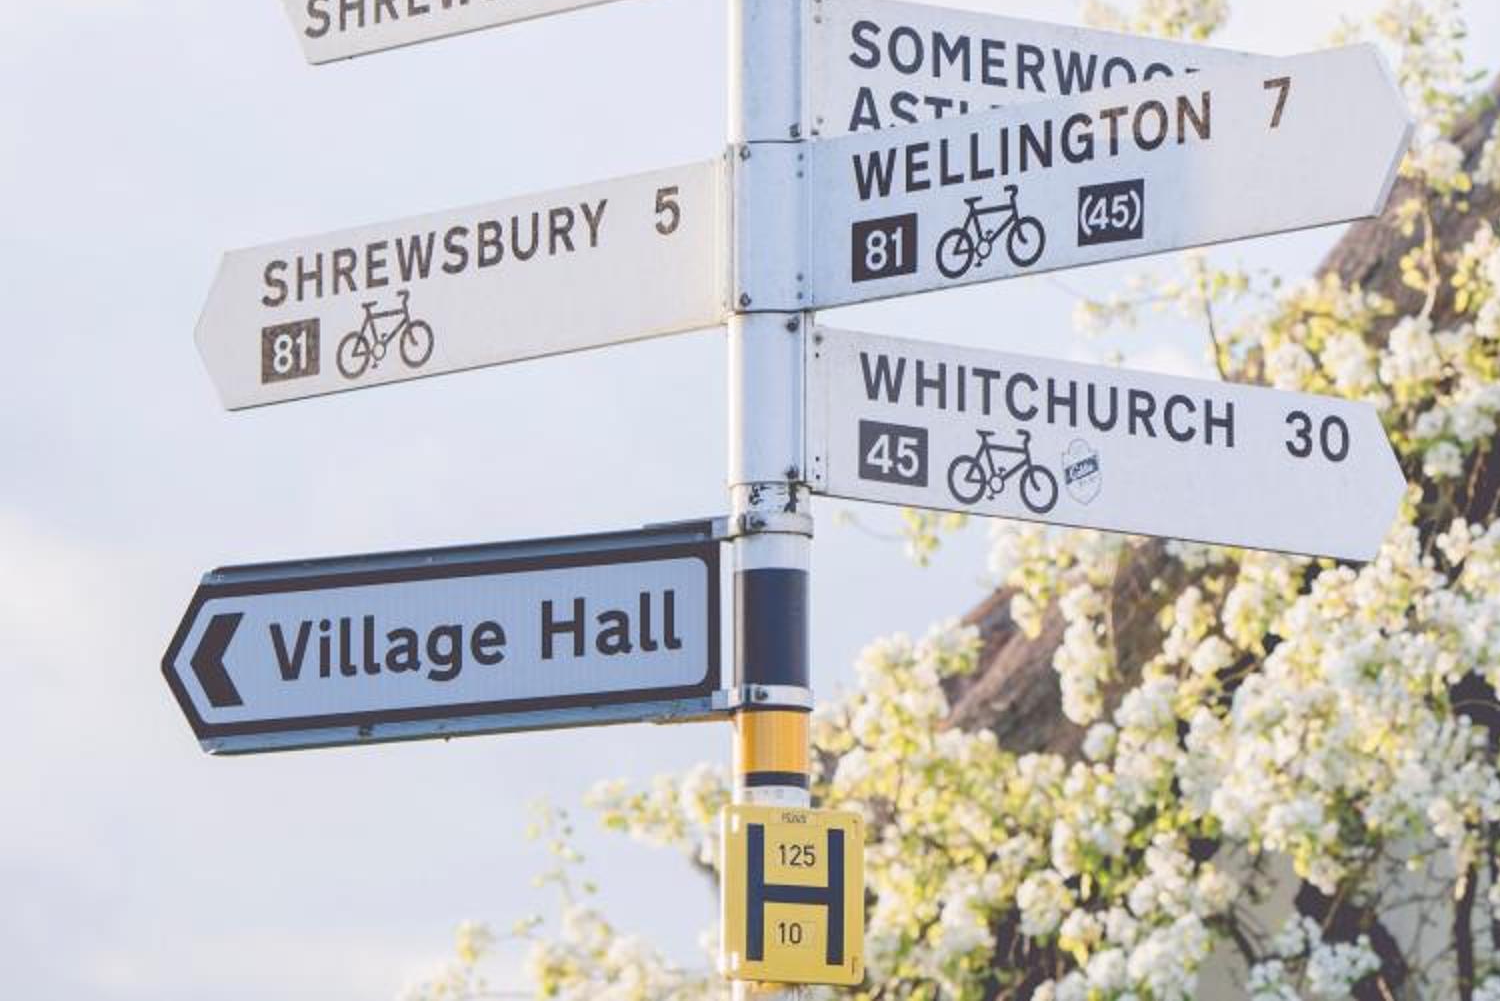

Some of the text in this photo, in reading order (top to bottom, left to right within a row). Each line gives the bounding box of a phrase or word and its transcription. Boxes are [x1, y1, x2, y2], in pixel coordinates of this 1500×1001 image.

[848, 20, 1200, 96] SOMERWO
[848, 86, 1001, 131] AST
[852, 76, 1292, 200] WELLINGTON 7
[261, 186, 681, 308] SHREWSBURY 5
[865, 189, 1143, 271] 81 (45)
[271, 333, 310, 374] 81
[860, 351, 1350, 463] WHITCHURCH 30
[866, 434, 920, 479] 45
[269, 589, 682, 683] Village Hall
[778, 844, 816, 867] 125
[778, 921, 803, 945] 10
